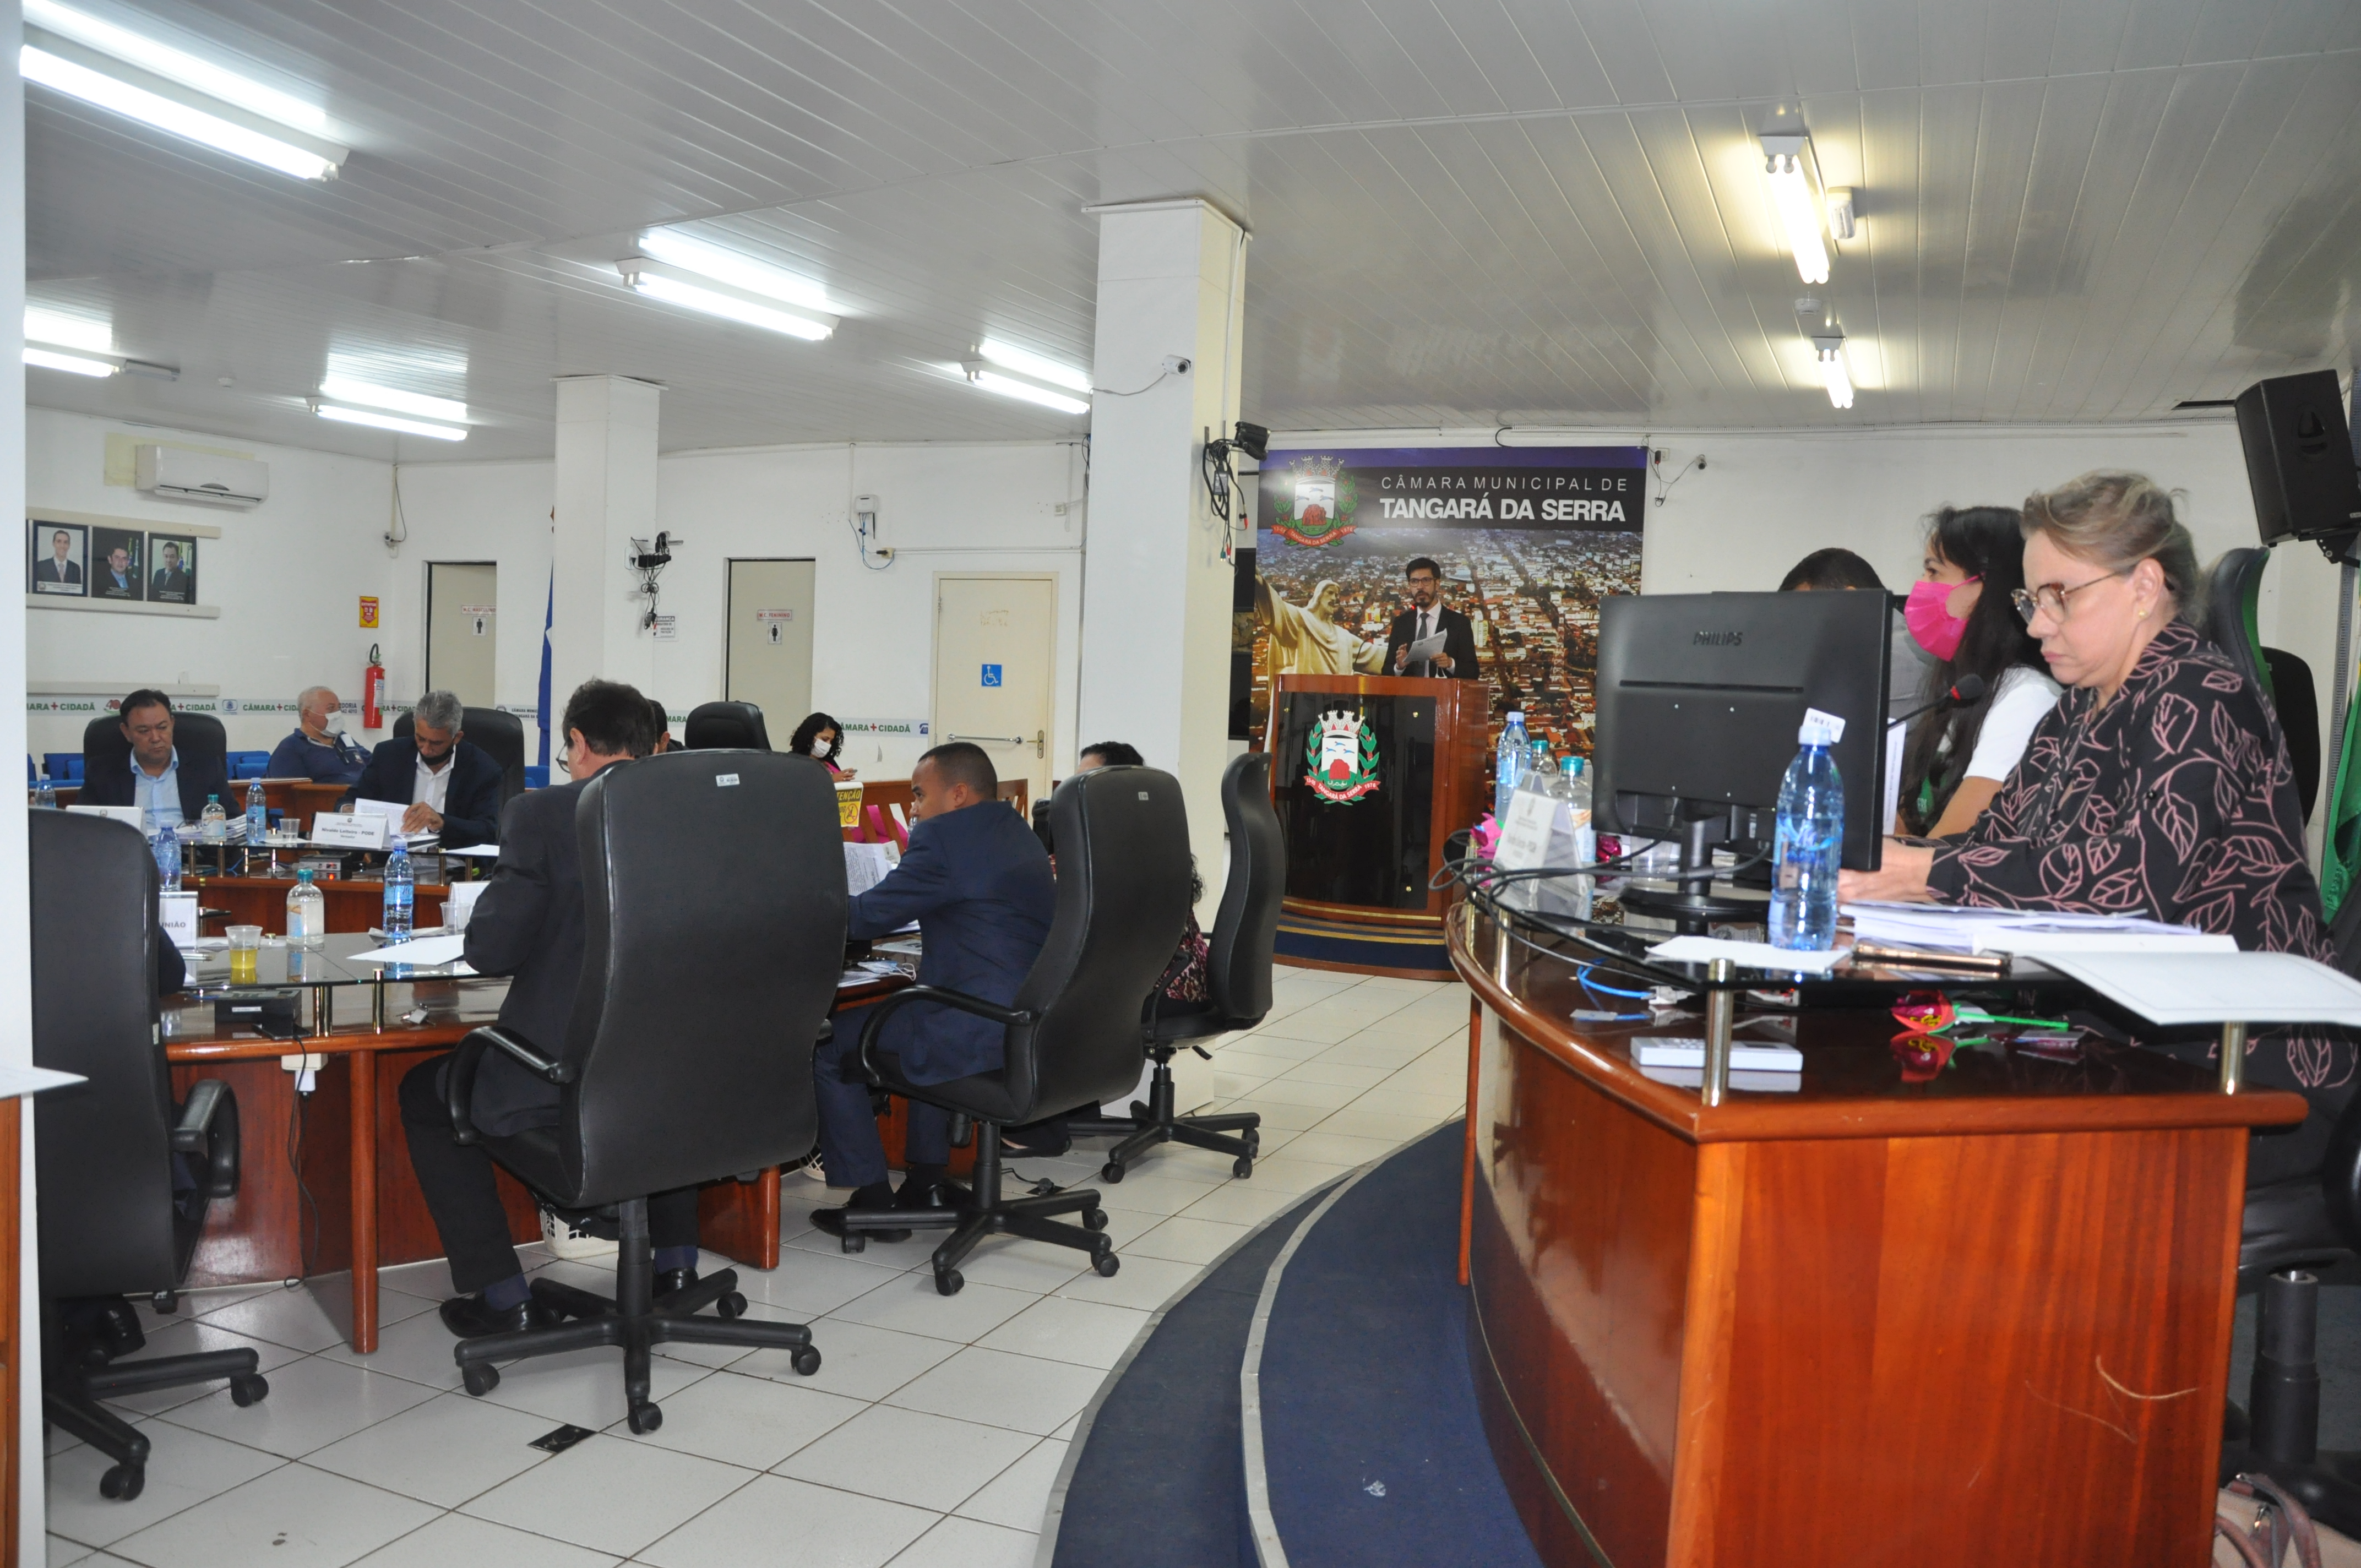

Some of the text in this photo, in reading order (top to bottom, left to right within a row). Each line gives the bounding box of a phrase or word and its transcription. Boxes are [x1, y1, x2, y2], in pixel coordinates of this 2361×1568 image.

[1381, 474, 1627, 491] CÂMARA MUNICIPAL DE
[1380, 492, 1625, 521] TANGARÁ DA SERRA
[1693, 631, 1743, 646] PHILIPS
[1347, 785, 1362, 797] SERRA
